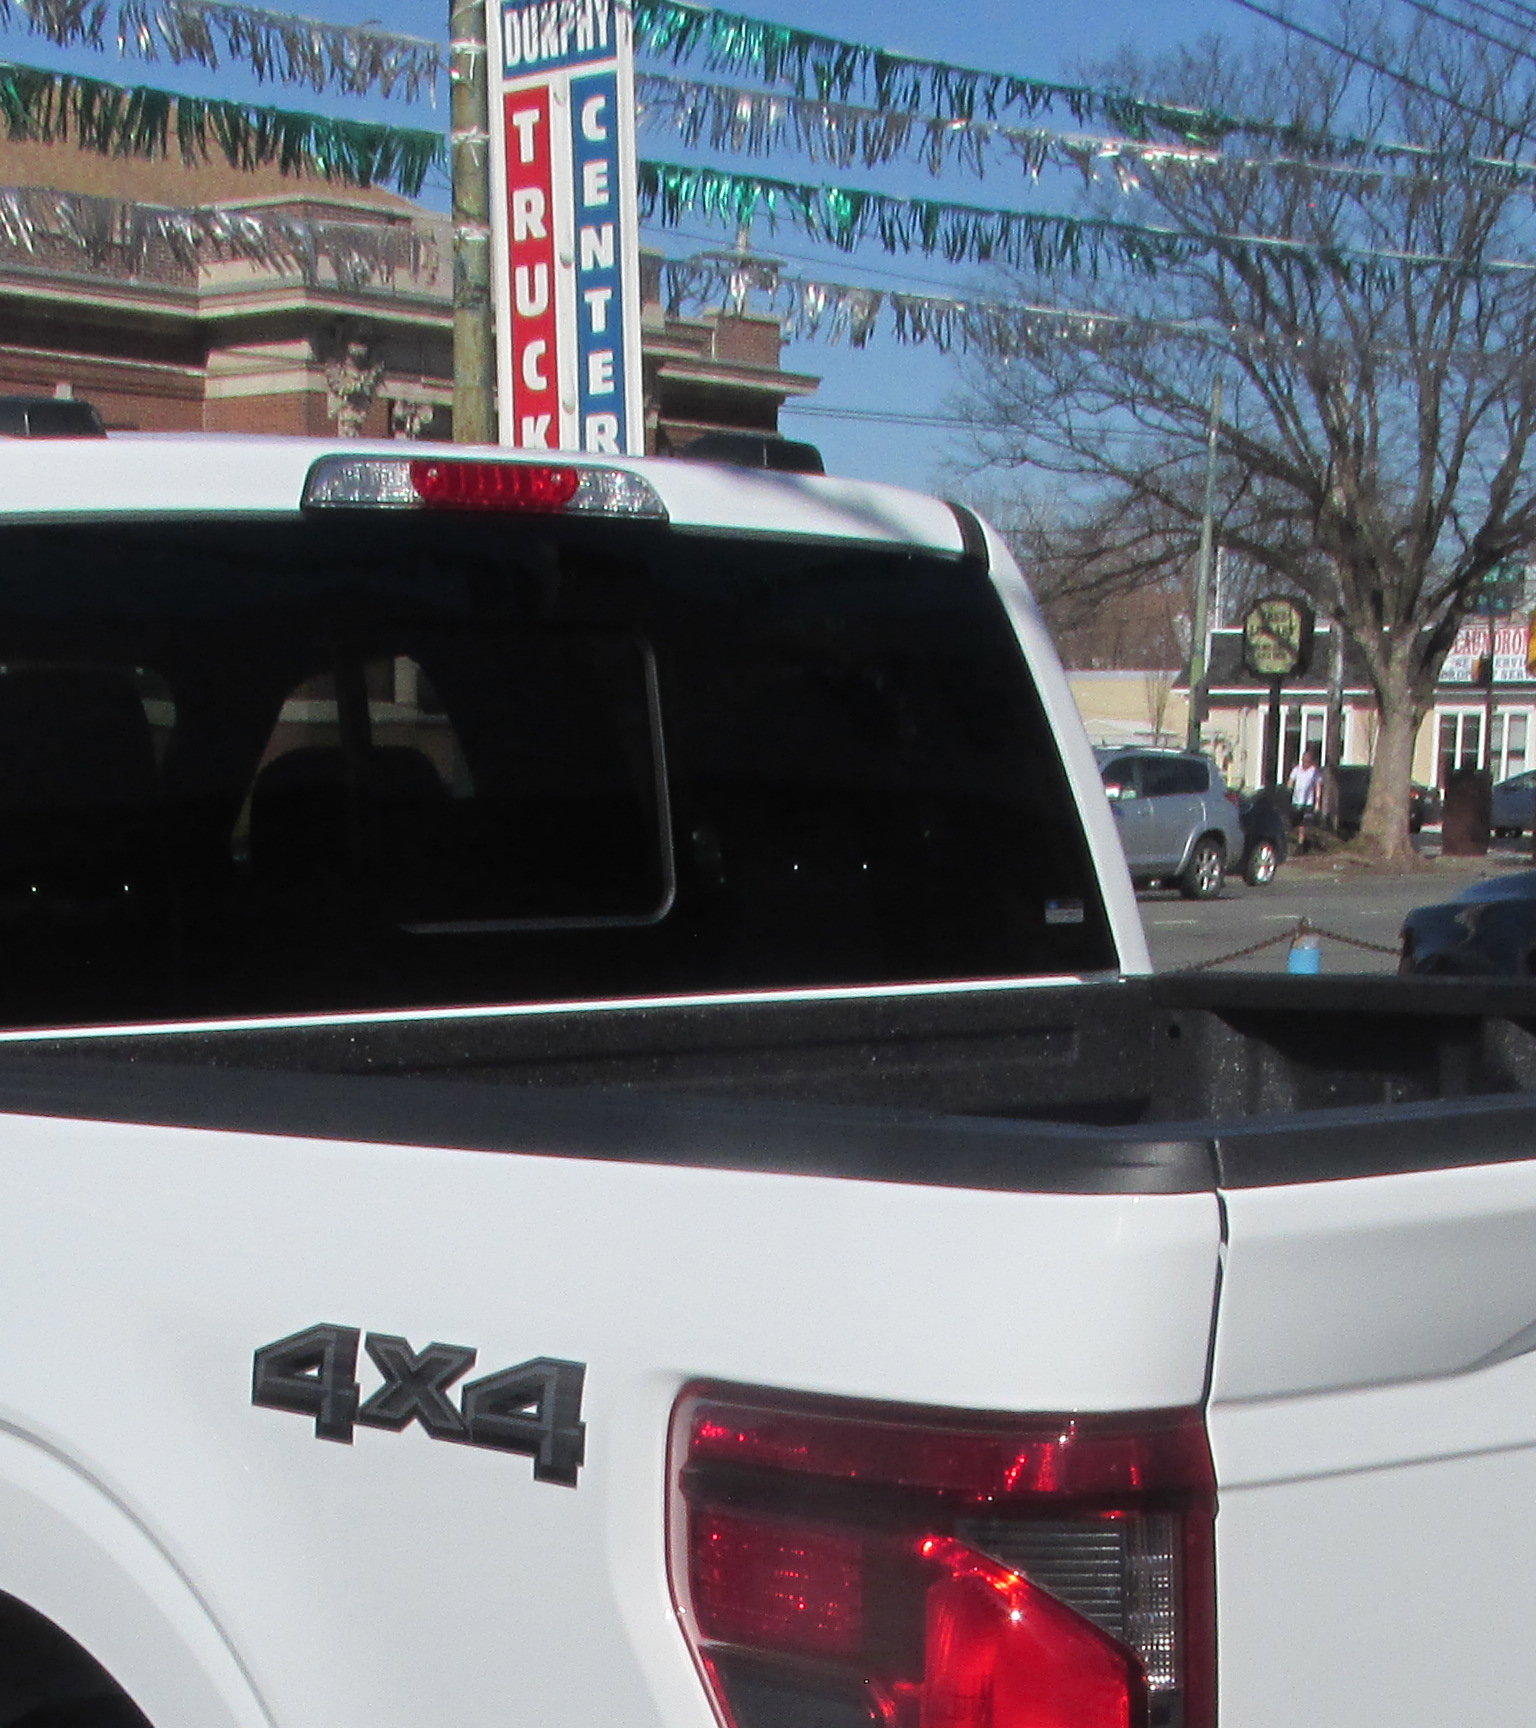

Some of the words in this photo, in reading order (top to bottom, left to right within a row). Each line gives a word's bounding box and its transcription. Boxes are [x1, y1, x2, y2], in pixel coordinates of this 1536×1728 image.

[512, 107, 552, 449] TRUCK
[580, 94, 621, 455] CENTER
[1453, 628, 1531, 655] LAUNDRO
